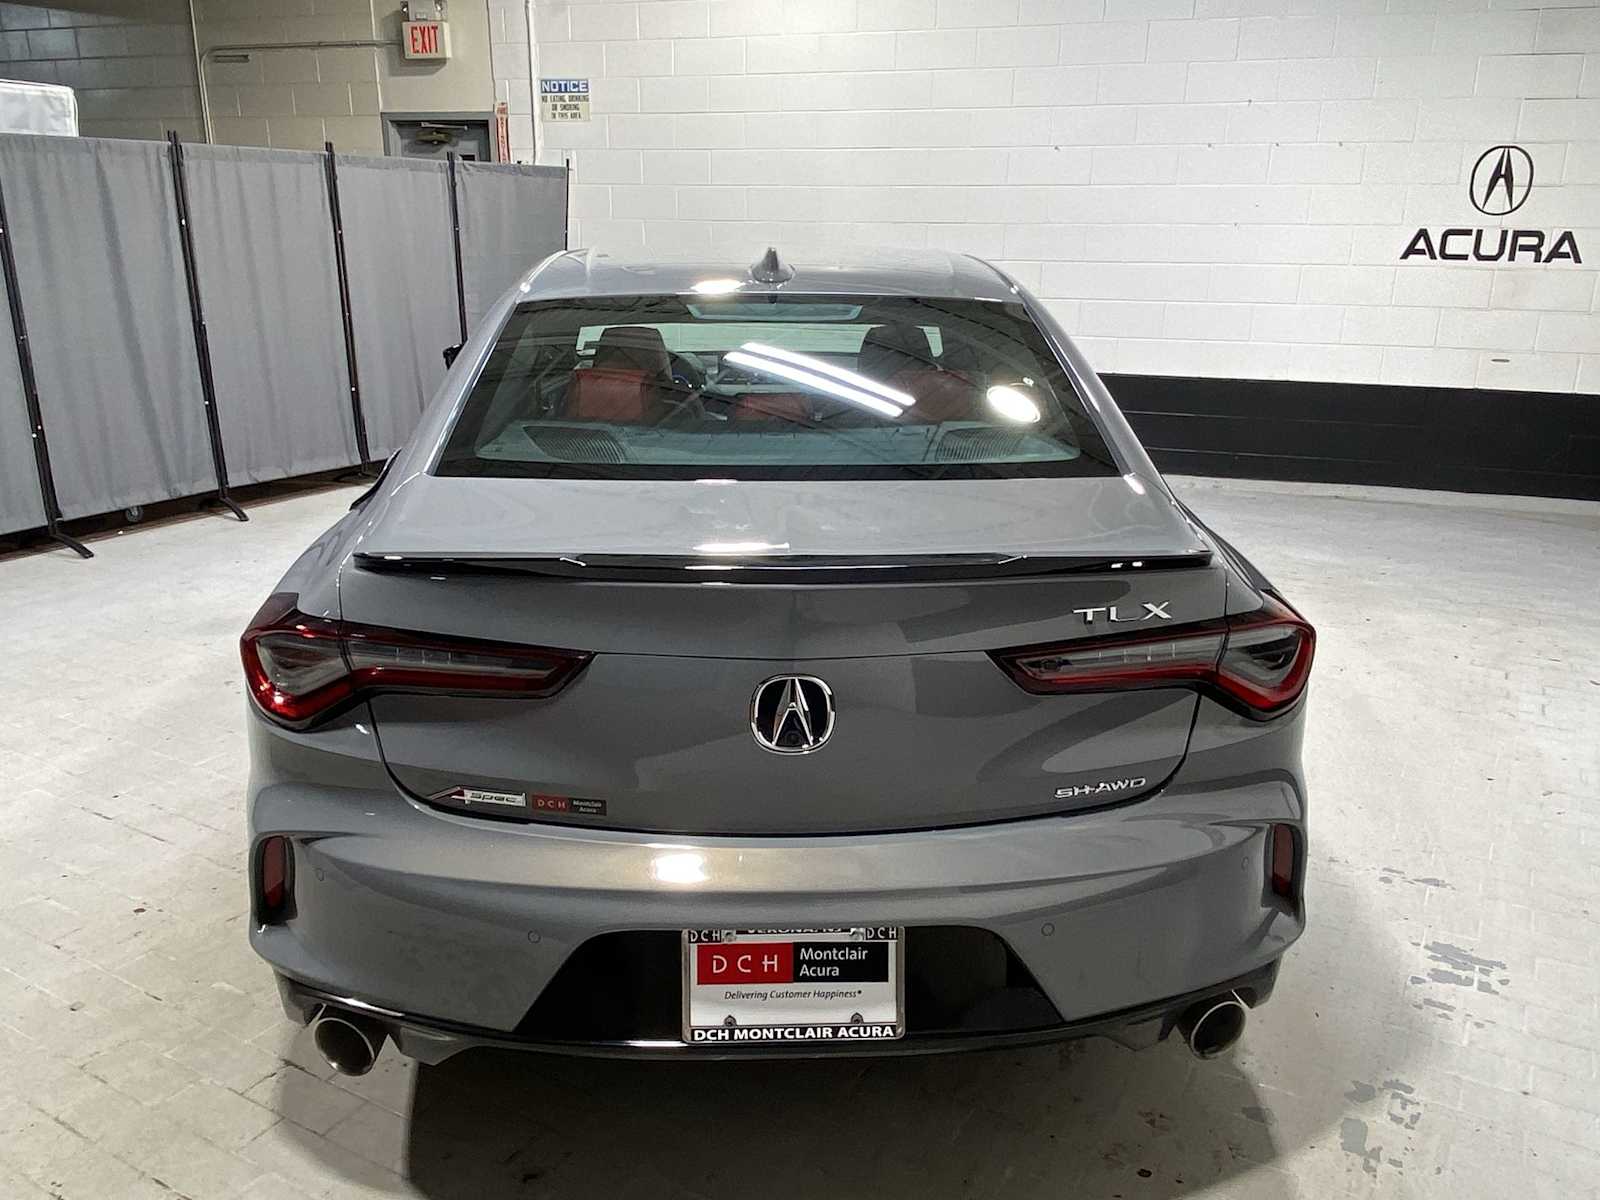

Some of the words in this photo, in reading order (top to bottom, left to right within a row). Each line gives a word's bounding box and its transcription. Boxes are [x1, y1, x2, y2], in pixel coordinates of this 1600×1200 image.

[410, 25, 439, 54] EXIT
[541, 80, 589, 92] NOTICE
[568, 95, 589, 103] DRINKING
[559, 103, 580, 112] SMOKING
[1400, 228, 1582, 264] ACURA
[1072, 601, 1172, 623] TLX
[1054, 777, 1146, 799] SH-AWD
[800, 947, 868, 960] Montclair
[800, 964, 840, 977] Acura
[724, 990, 768, 1001] Delivering
[769, 989, 812, 999] Customer
[694, 1029, 730, 1041] DCH
[733, 1027, 833, 1040] MONTCLAIR
[837, 1026, 894, 1038] ACURA
